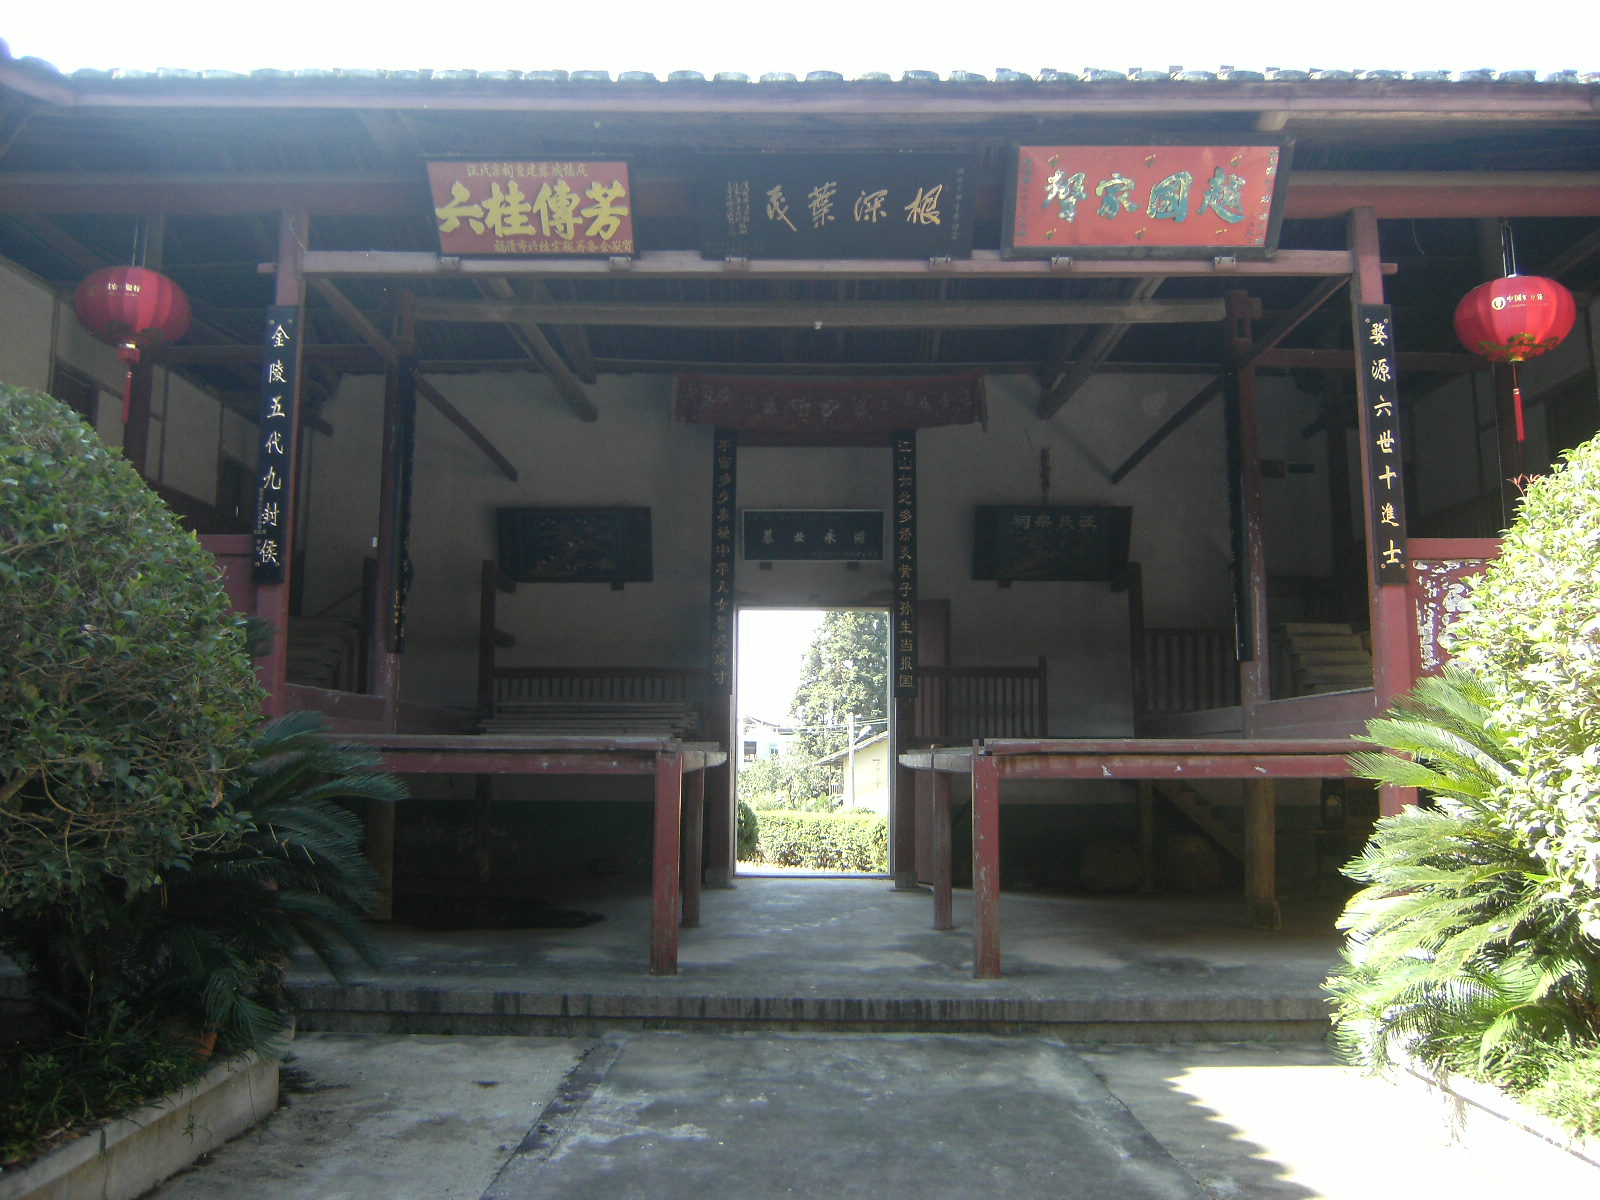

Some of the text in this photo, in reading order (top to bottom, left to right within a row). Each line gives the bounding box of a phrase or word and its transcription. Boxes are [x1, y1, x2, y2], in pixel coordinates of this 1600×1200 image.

[435, 179, 629, 241] 六桂傳芳
[766, 181, 944, 232] 根深葉茂
[1041, 165, 1246, 225] 越國家聲
[260, 323, 291, 563] 金陵五代九封侯
[1369, 322, 1402, 564] 婺源六世十進士
